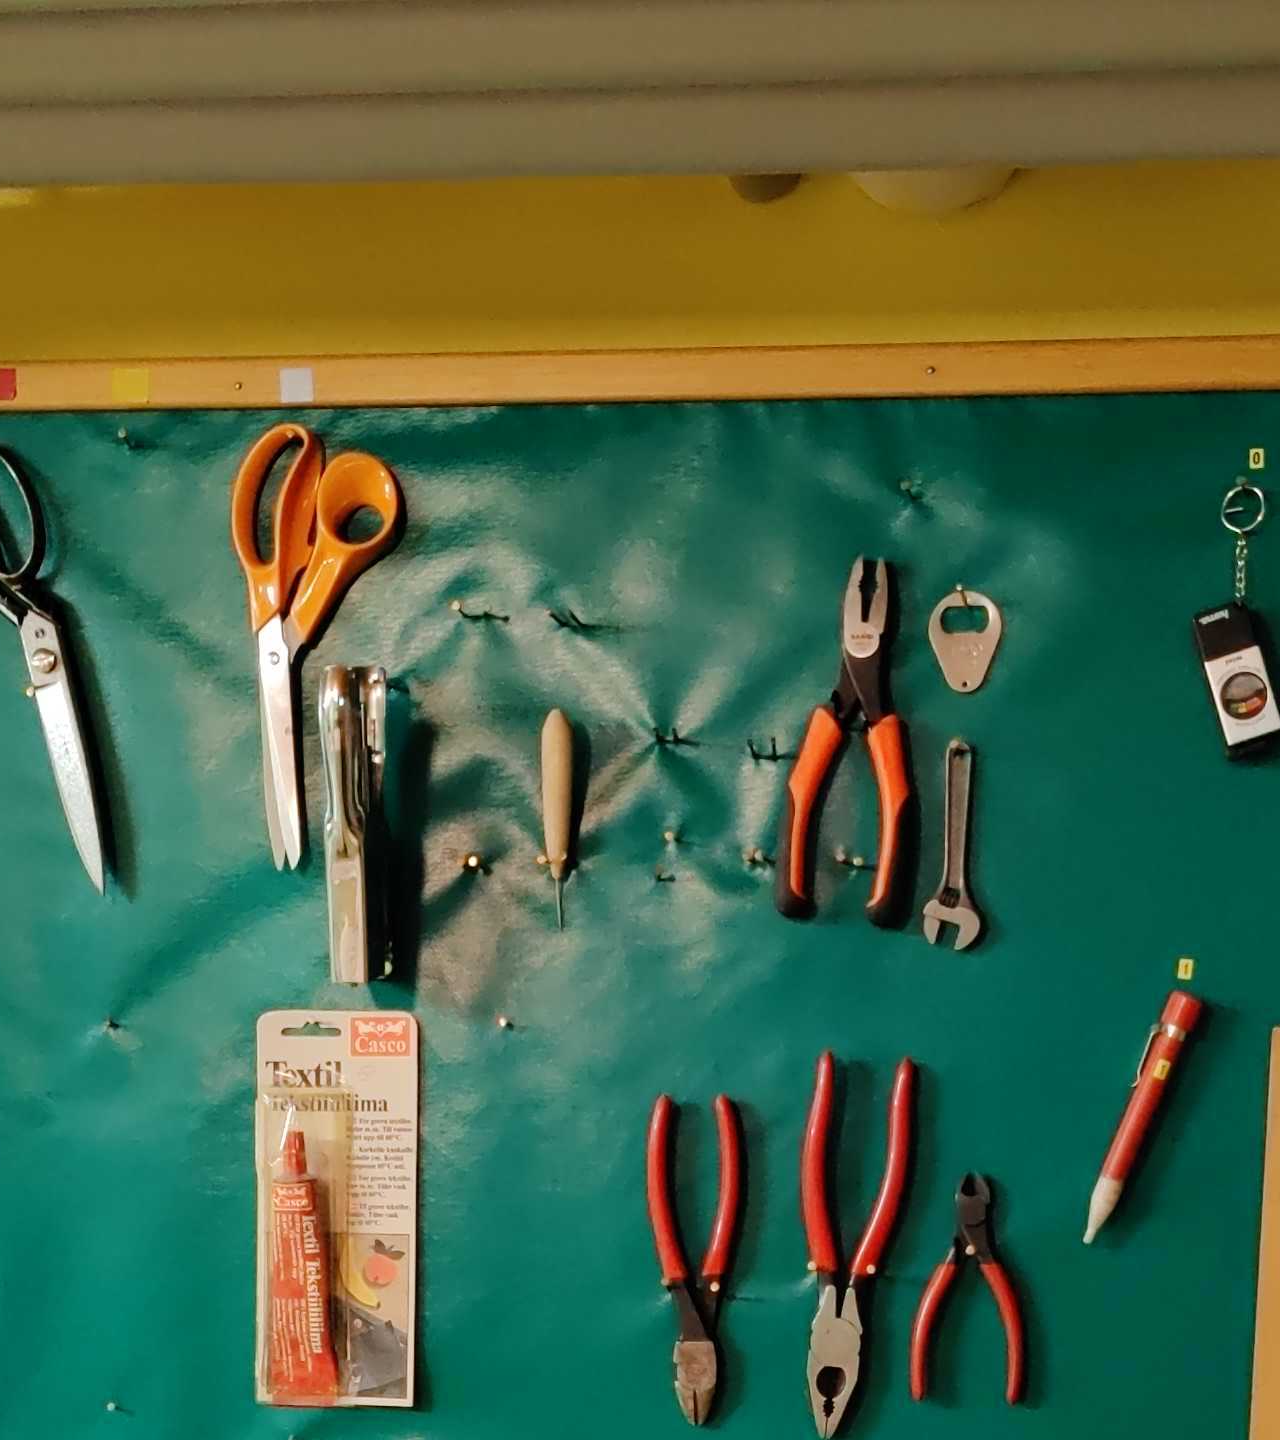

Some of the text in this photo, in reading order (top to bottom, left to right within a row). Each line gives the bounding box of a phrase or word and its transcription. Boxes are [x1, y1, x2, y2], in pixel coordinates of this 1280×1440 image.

[354, 1036, 407, 1053] Casco
[265, 1060, 343, 1088] Textil
[302, 1215, 320, 1255] Textil
